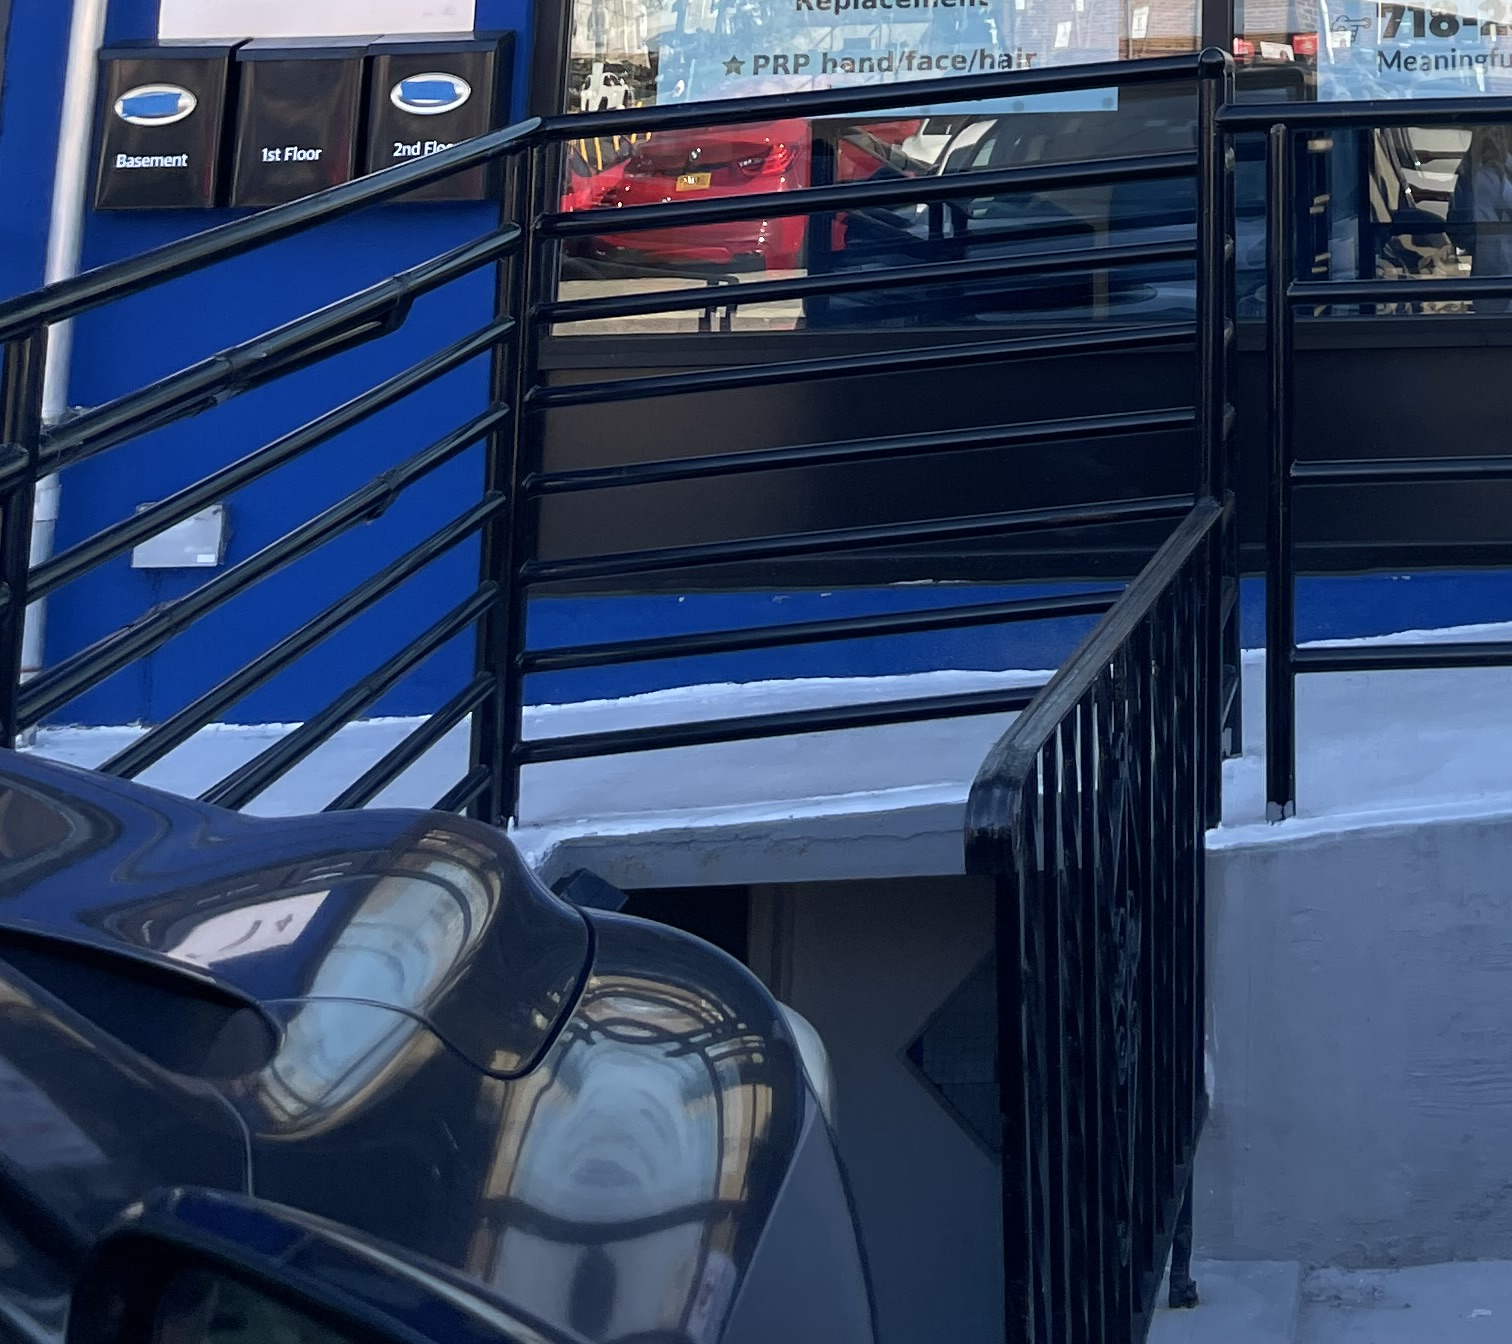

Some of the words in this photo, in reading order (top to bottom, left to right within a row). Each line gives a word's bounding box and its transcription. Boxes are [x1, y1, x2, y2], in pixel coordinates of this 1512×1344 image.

[752, 53, 811, 76] PRP
[821, 47, 1038, 75] hand/face/hair
[261, 146, 280, 163] 1st
[284, 145, 323, 162] Floor
[393, 140, 421, 157] 2nd
[116, 152, 188, 169] Basement
